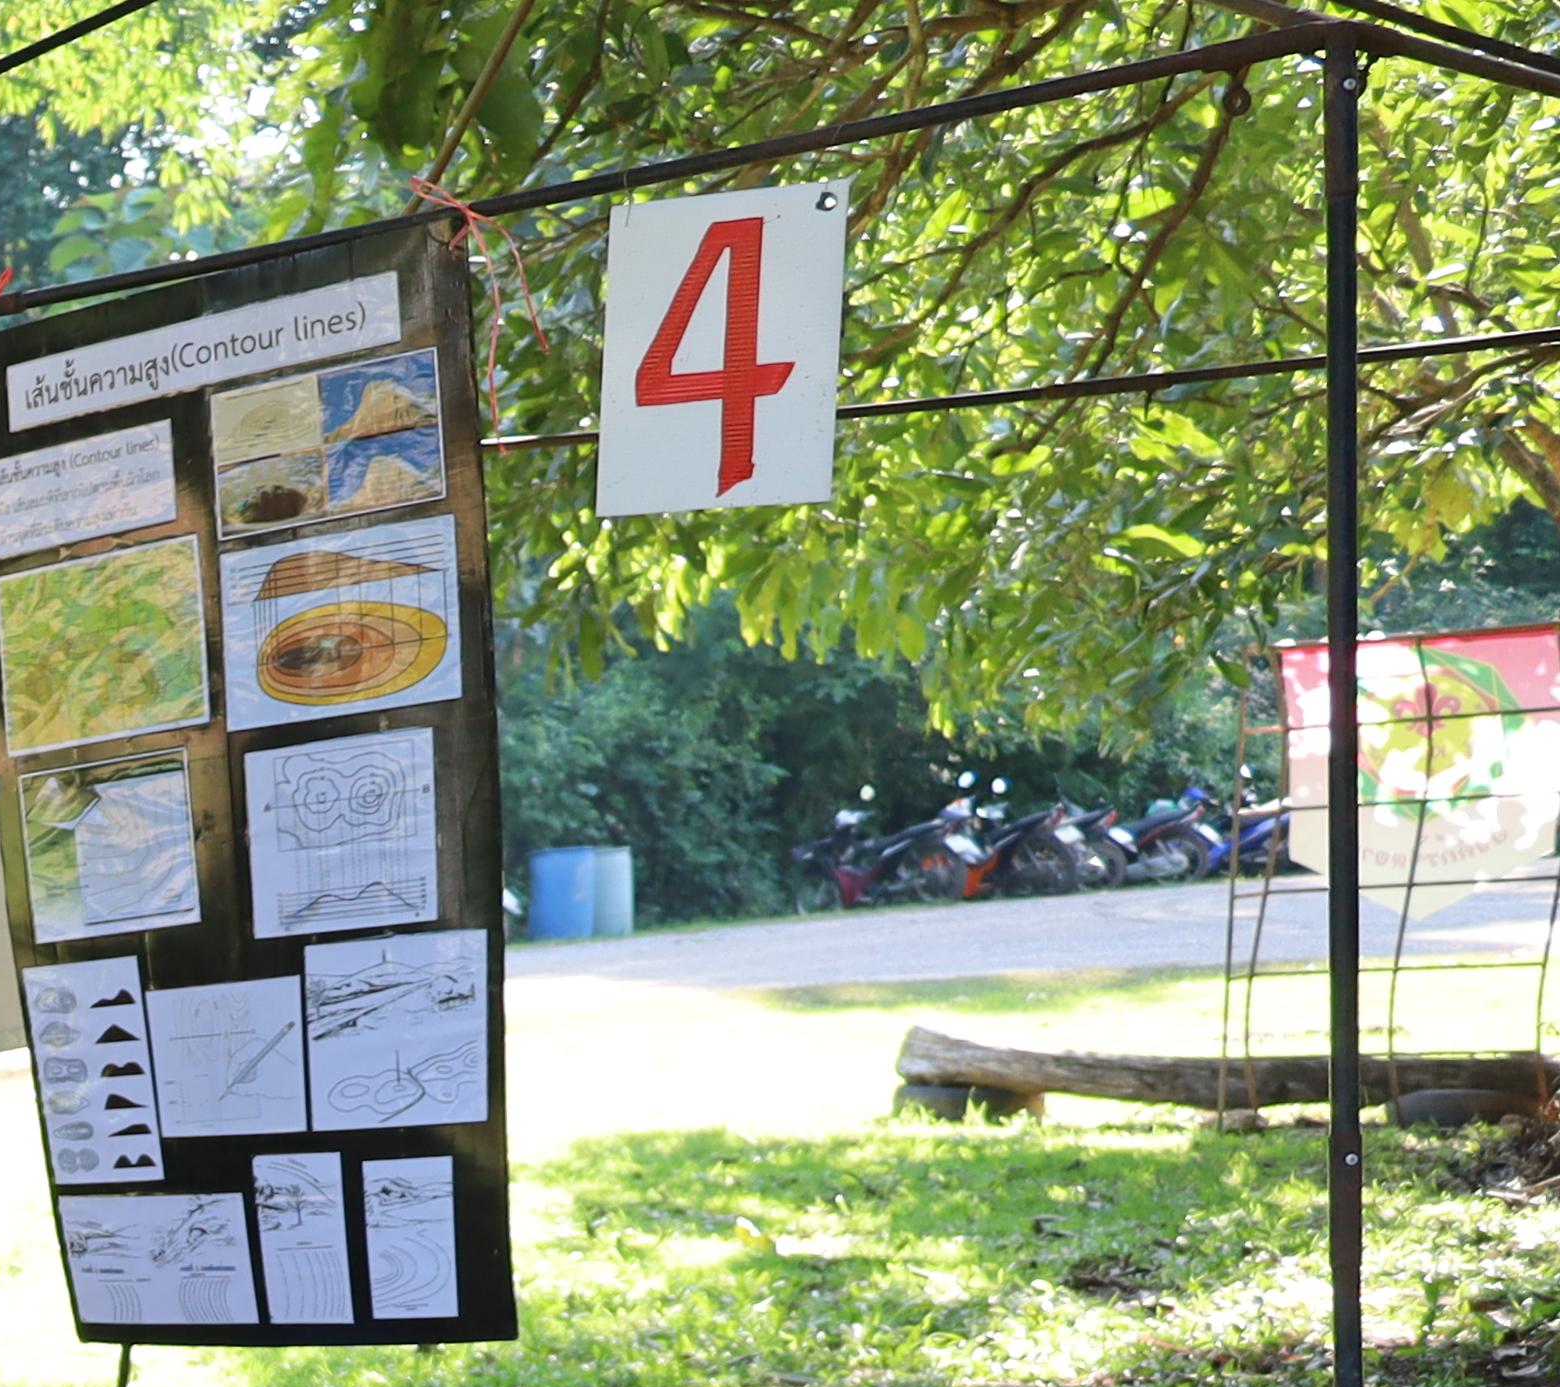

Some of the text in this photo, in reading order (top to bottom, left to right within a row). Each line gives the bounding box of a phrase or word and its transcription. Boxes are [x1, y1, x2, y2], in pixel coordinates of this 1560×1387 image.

[294, 301, 366, 341] lines)
[635, 216, 795, 497] 4
[70, 446, 121, 470] (Contour
